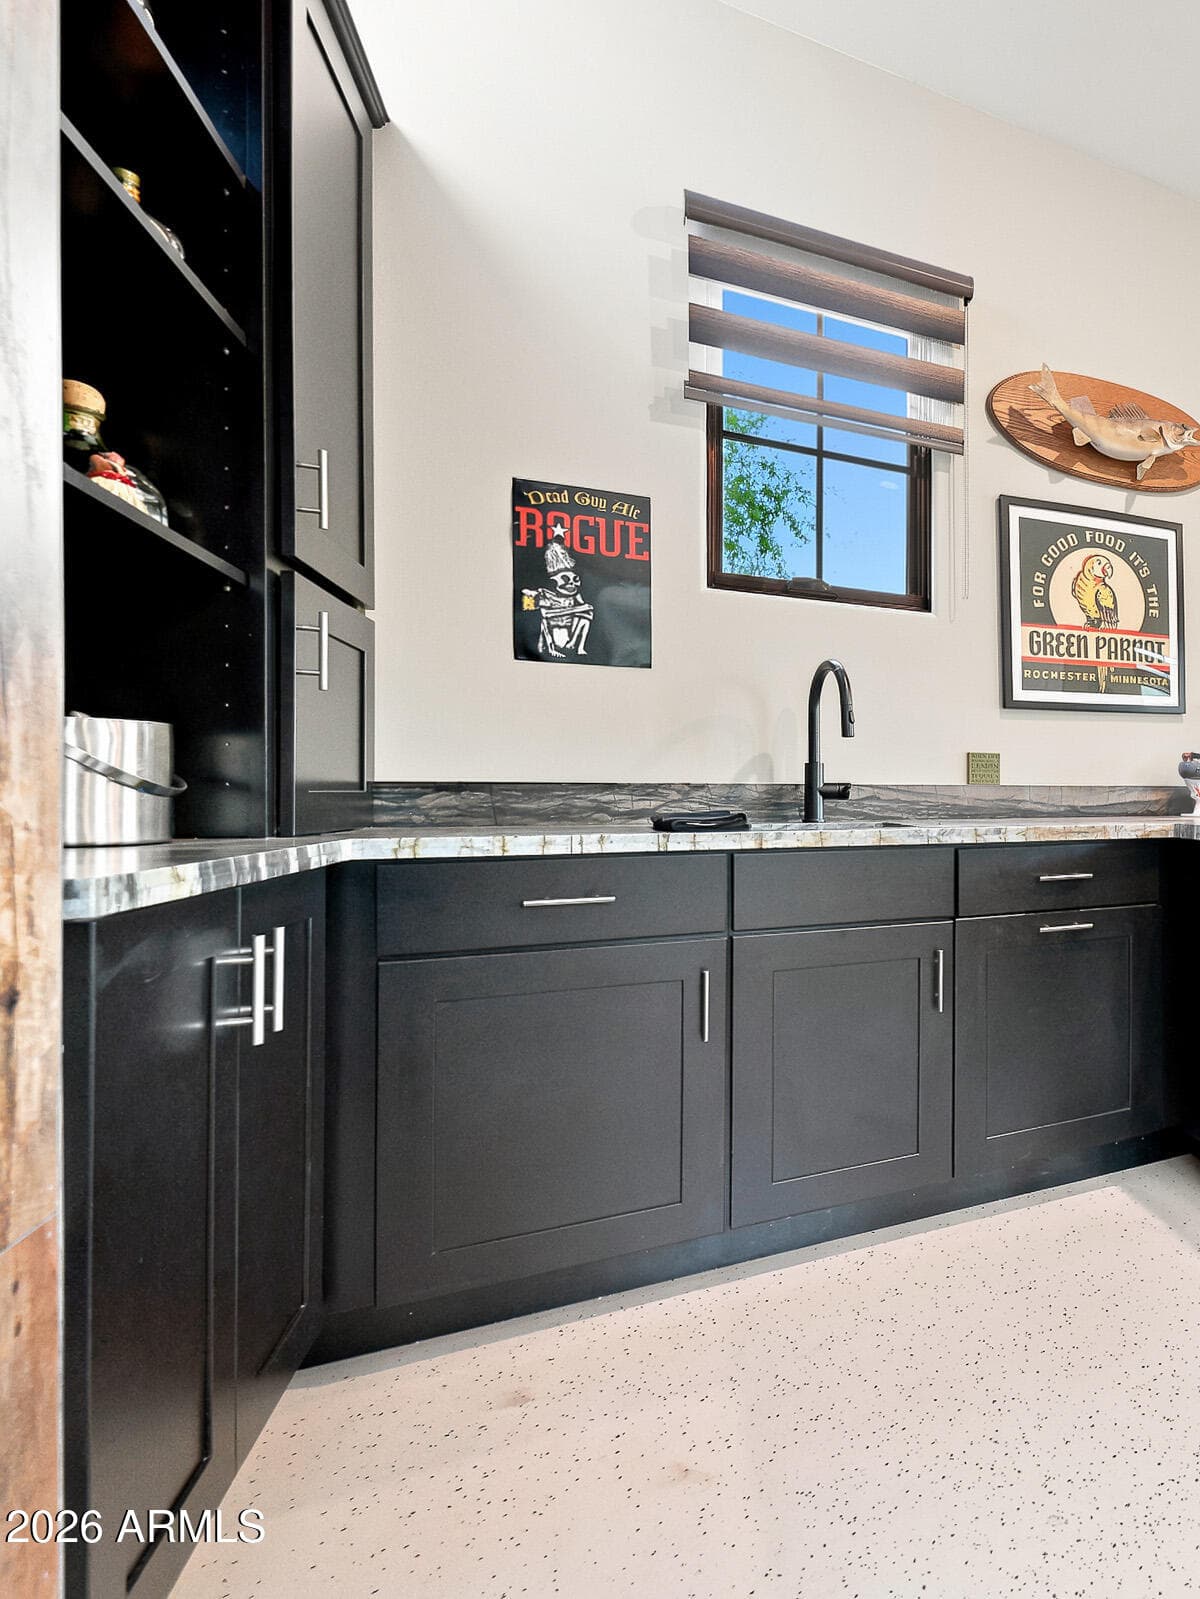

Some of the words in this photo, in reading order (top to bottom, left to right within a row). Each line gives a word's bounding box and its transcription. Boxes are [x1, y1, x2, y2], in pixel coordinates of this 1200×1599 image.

[524, 490, 569, 505] Dead
[574, 491, 607, 512] Guy
[611, 501, 641, 520] Ale
[515, 506, 650, 561] ROGUE
[1032, 571, 1048, 609] FOR
[1041, 533, 1079, 567] GOOD
[1085, 530, 1126, 553] FOOD
[1128, 551, 1151, 578] IT'S
[1146, 583, 1160, 619] THE
[1028, 630, 1089, 659] GREEN
[1096, 635, 1166, 664] PARROT
[1023, 669, 1097, 682] ROCHESTER
[1110, 674, 1169, 687] MINNESOTA
